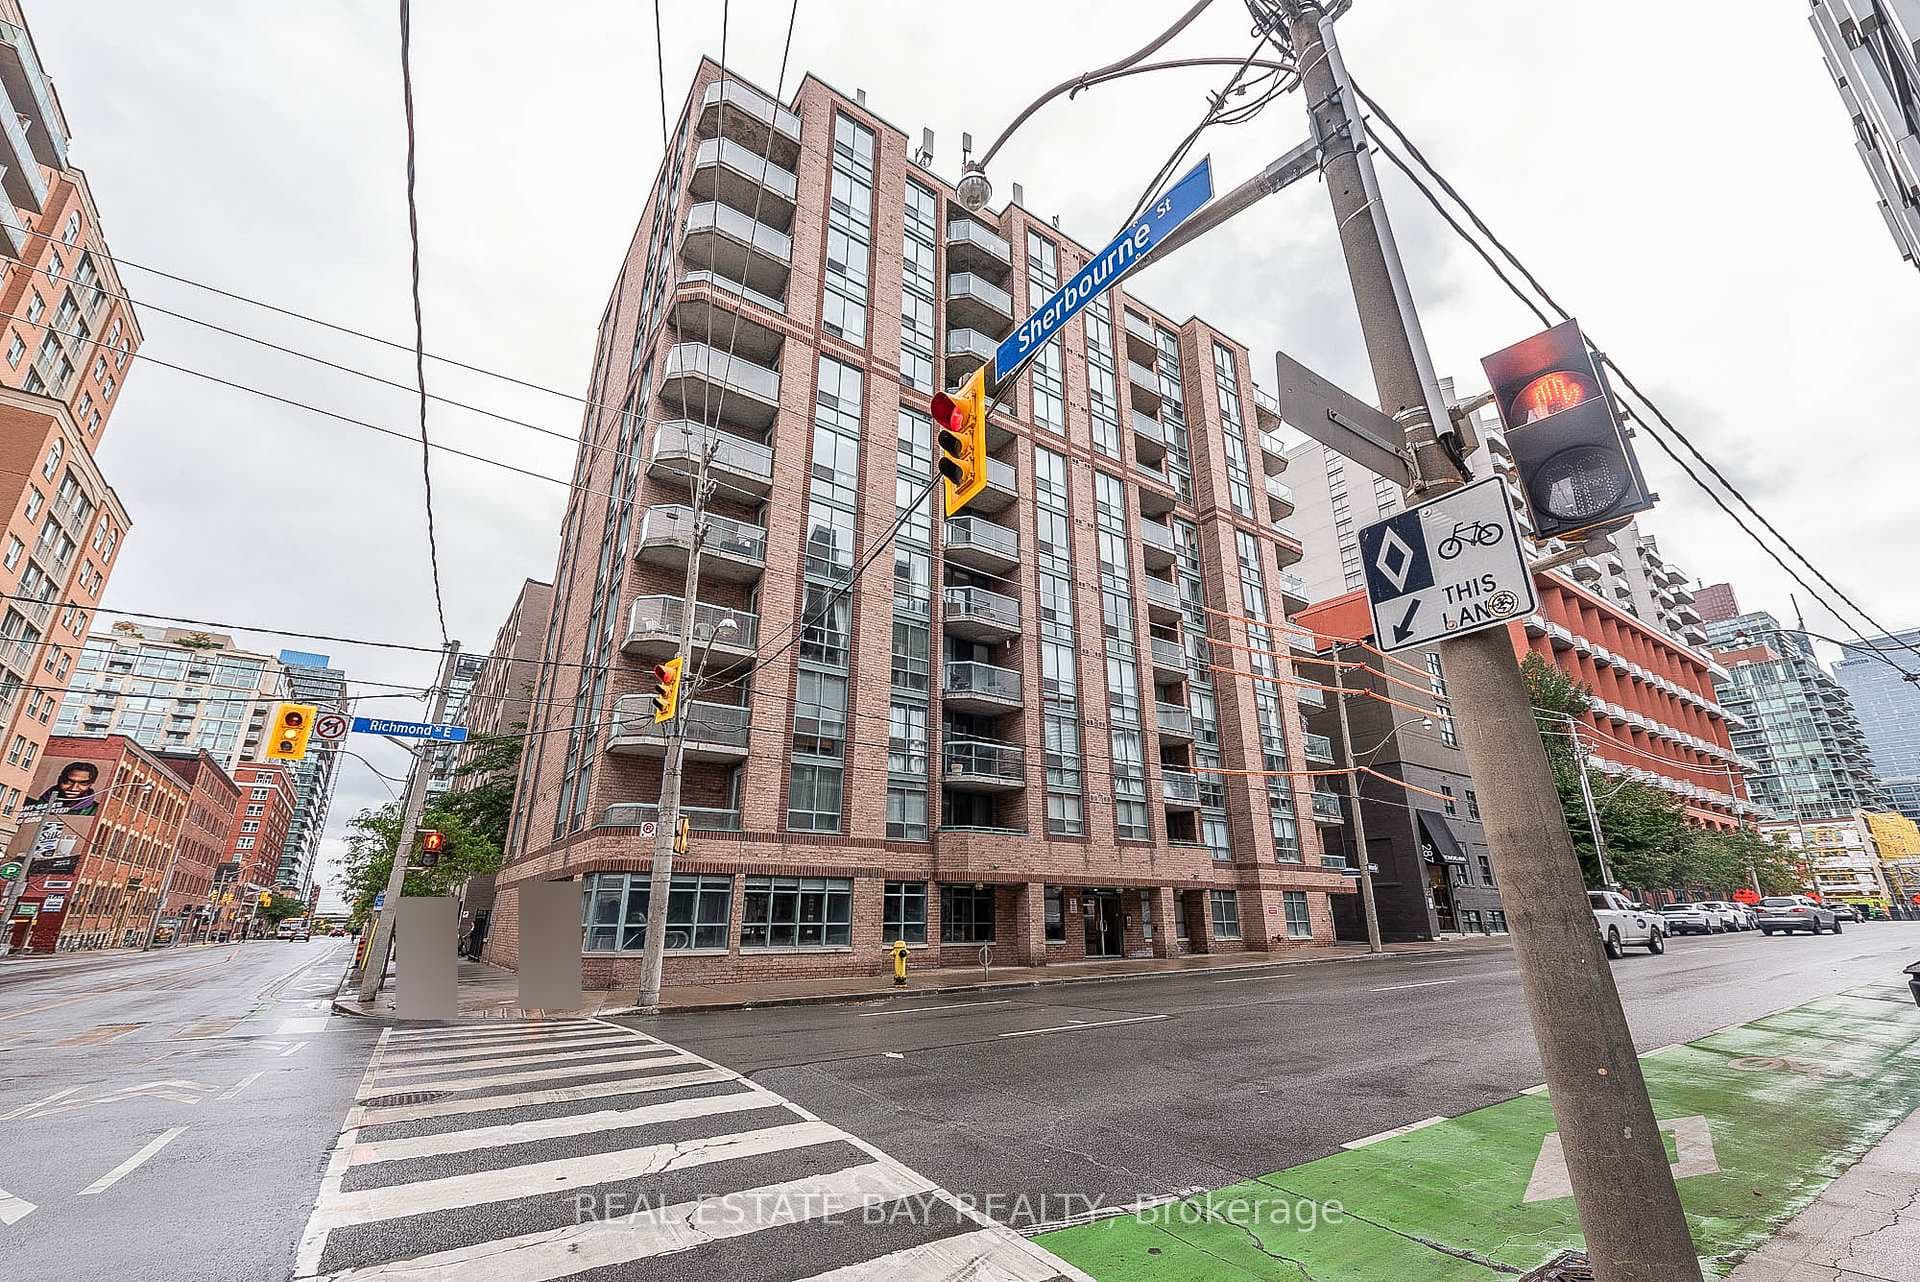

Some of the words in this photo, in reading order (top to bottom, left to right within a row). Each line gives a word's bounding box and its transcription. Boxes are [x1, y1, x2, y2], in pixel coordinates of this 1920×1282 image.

[1018, 221, 1152, 353] Sherbourne
[1156, 197, 1172, 219] St
[1442, 573, 1497, 605] THIS
[1443, 601, 1492, 631] LAN
[369, 720, 432, 736] Richmond
[443, 727, 452, 738] E
[39, 831, 62, 841] Silk
[1421, 843, 1435, 864] 287
